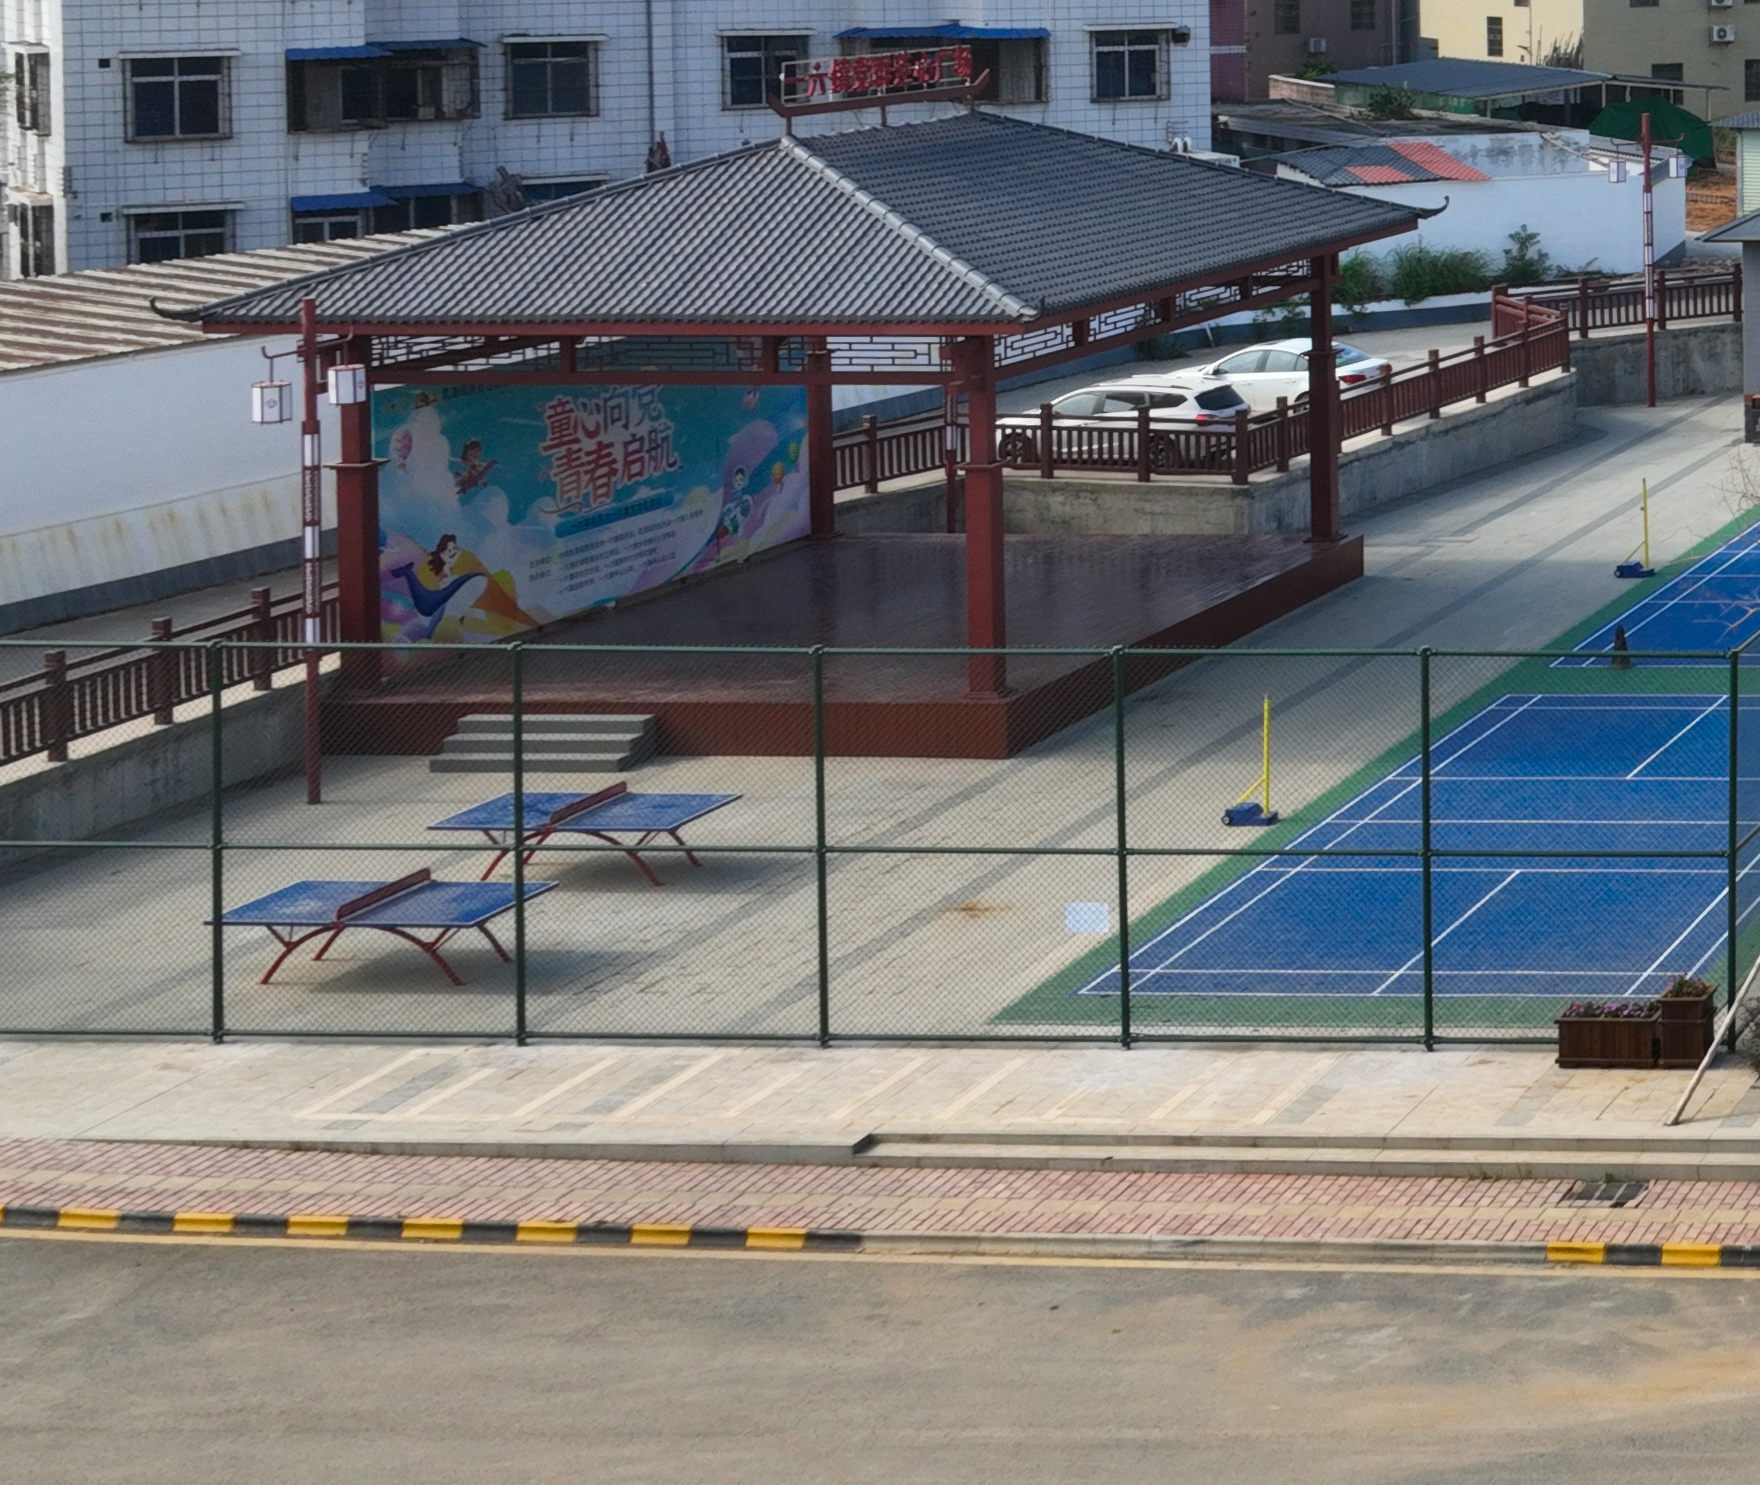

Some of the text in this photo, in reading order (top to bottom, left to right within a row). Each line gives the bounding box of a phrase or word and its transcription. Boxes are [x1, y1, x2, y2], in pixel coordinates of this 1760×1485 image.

[542, 384, 663, 453] 童心向党
[553, 424, 678, 503] 青春启航
